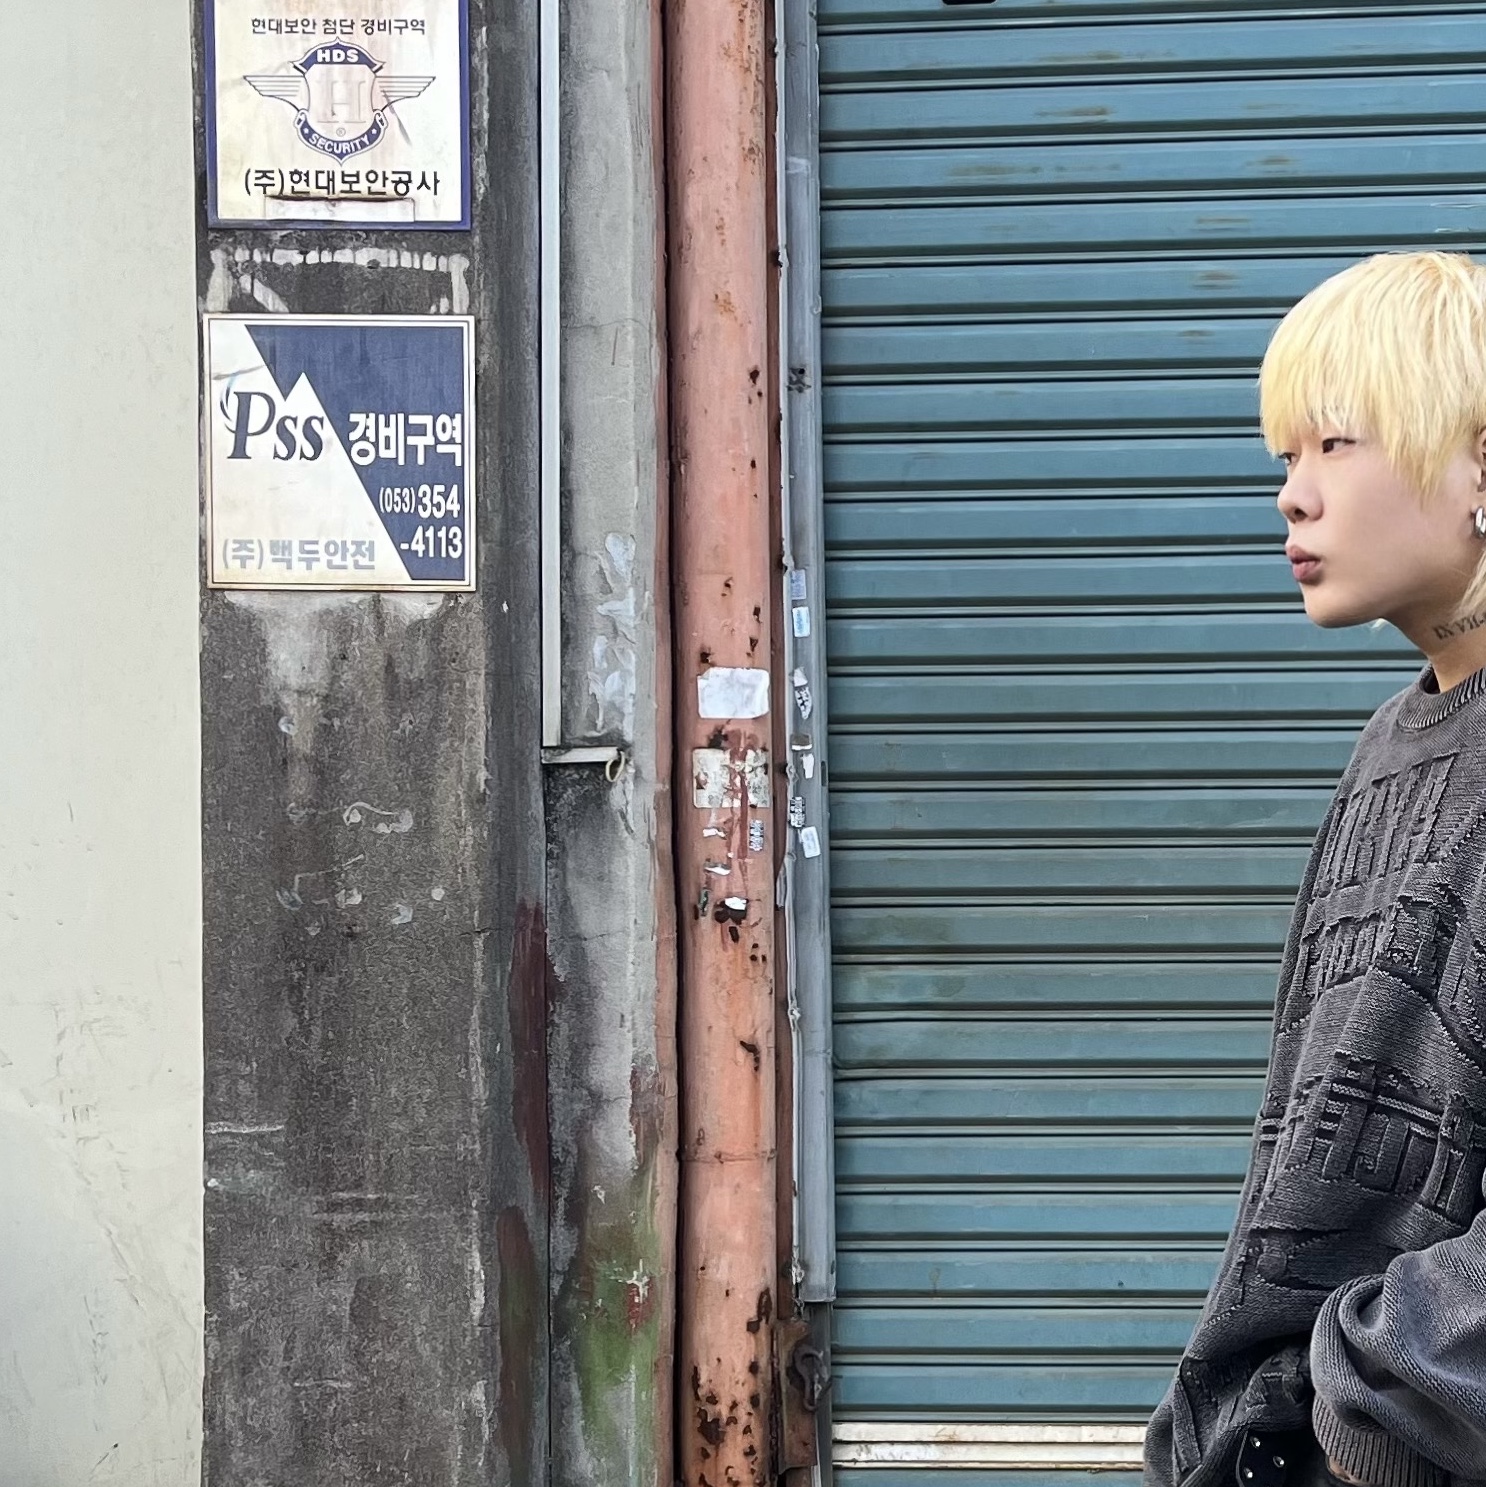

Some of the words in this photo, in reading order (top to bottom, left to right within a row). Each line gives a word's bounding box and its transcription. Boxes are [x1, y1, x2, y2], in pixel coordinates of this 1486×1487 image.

[251, 18, 317, 35] 현대보안
[322, 18, 355, 35] 첨단
[361, 18, 425, 36] 경비구역
[316, 49, 359, 63] HDS
[308, 133, 370, 154] SECURITY
[244, 168, 440, 197] (주)현대보안공사
[348, 412, 463, 467] 경비구역
[379, 484, 461, 519] (053)354
[222, 538, 376, 571] (주)백두안전
[400, 525, 463, 559] -4113
